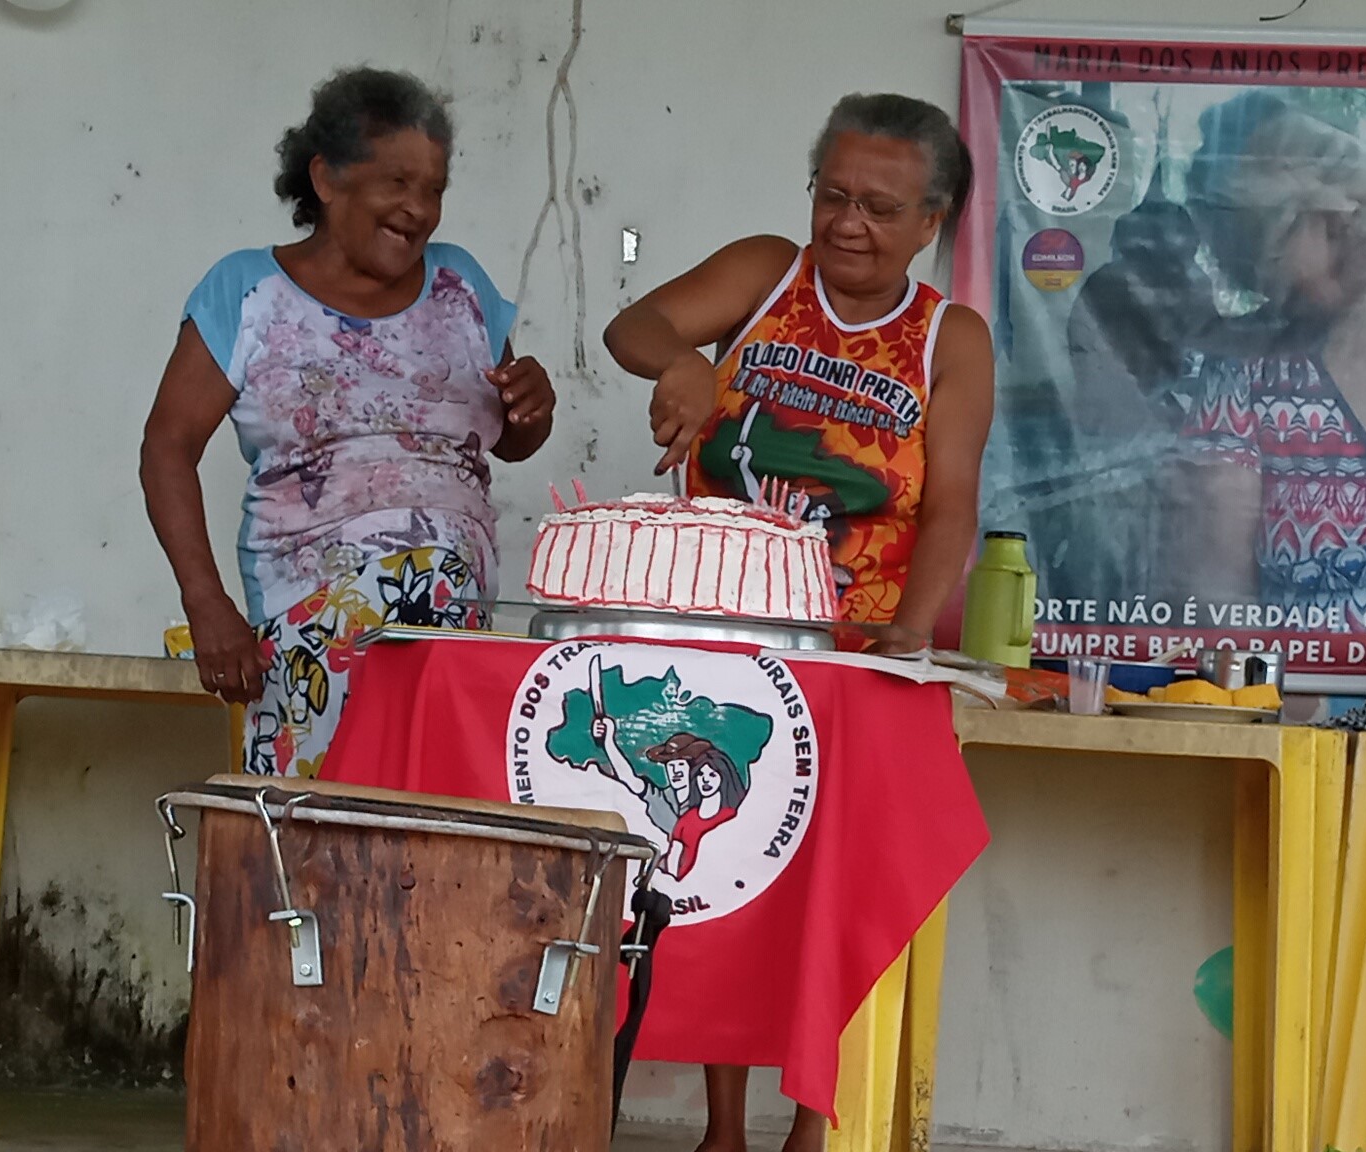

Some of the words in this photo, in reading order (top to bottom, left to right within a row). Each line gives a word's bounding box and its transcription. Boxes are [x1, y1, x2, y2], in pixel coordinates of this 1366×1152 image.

[1034, 44, 1123, 72] MARIA
[1138, 46, 1193, 75] DOS
[1209, 49, 1302, 78] ANJOS
[802, 350, 858, 390] LONA
[1034, 598, 1097, 621] ORTE
[1108, 594, 1172, 625] NÃO
[1182, 596, 1198, 625] É
[520, 672, 550, 720] DOS
[746, 654, 804, 719] URAIS
[792, 725, 812, 777] SEM
[763, 784, 810, 859] TERRA
